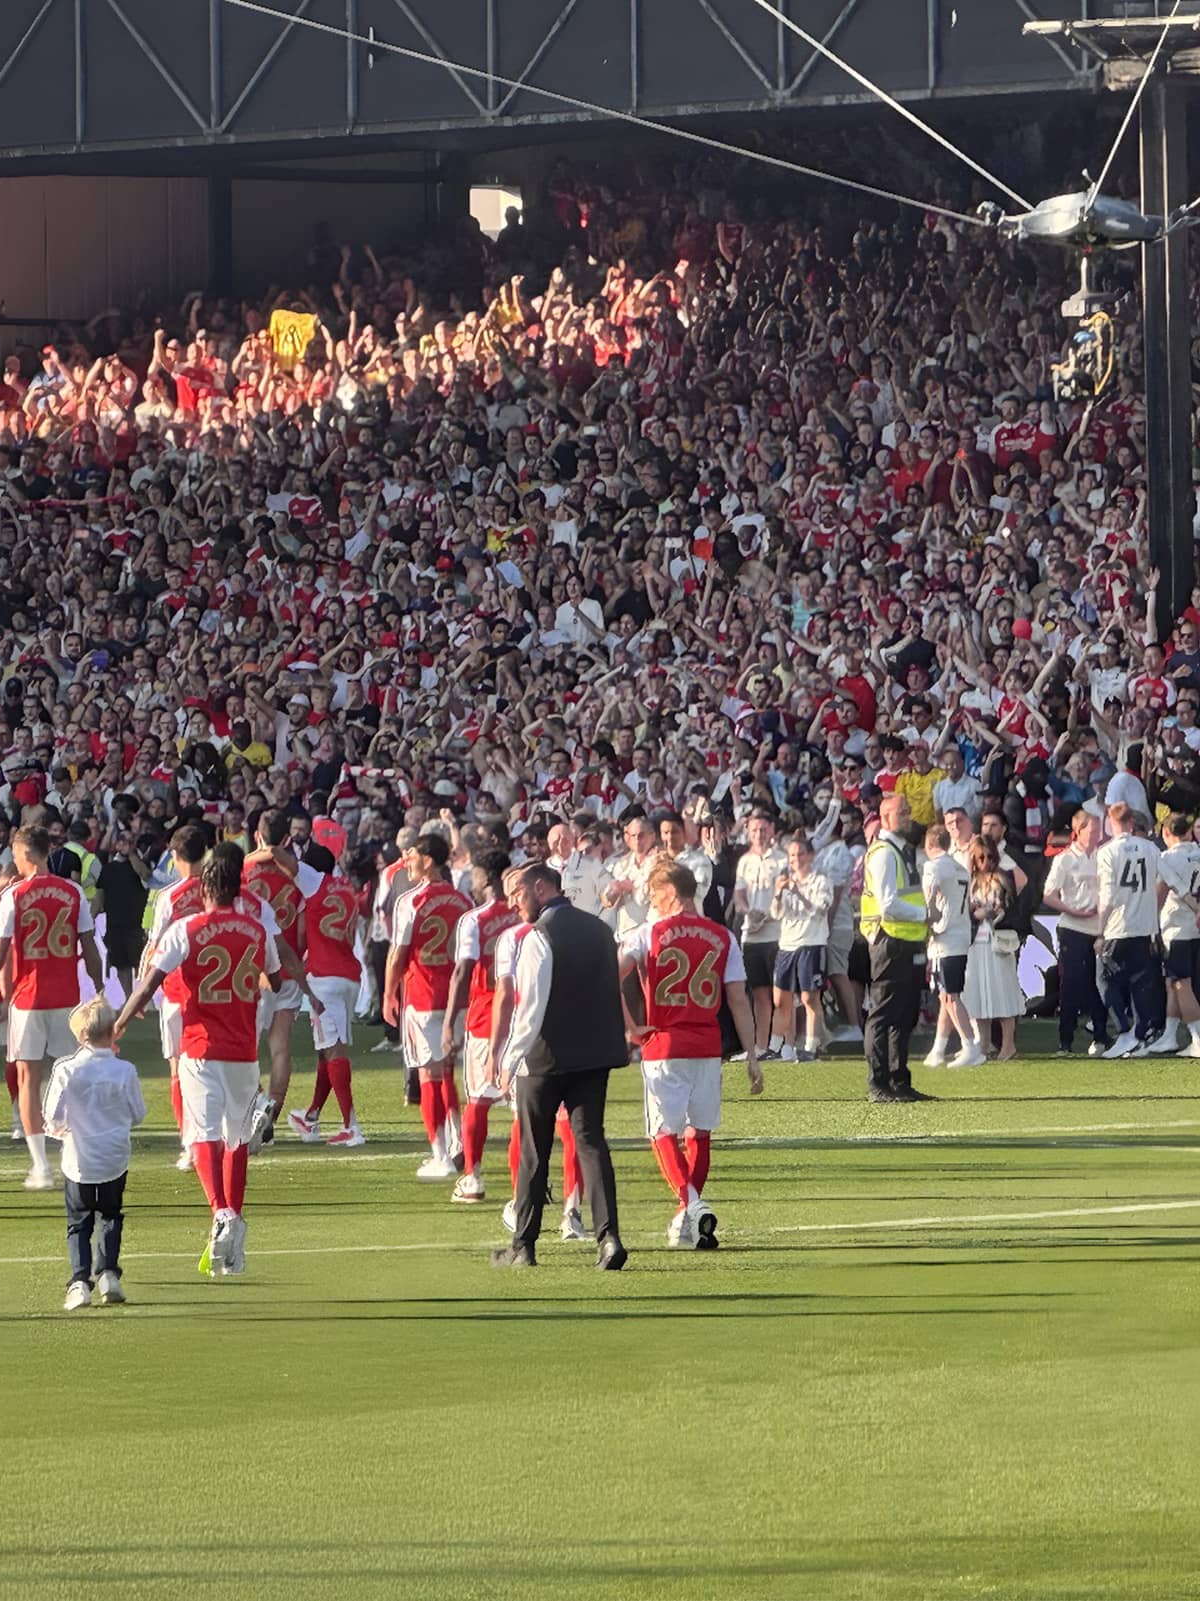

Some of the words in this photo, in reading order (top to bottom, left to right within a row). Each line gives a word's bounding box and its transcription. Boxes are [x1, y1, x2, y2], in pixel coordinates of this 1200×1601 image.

[1120, 857, 1147, 893] 41
[20, 907, 75, 959] 26
[197, 944, 260, 1004] 26
[655, 946, 721, 1009] 26
